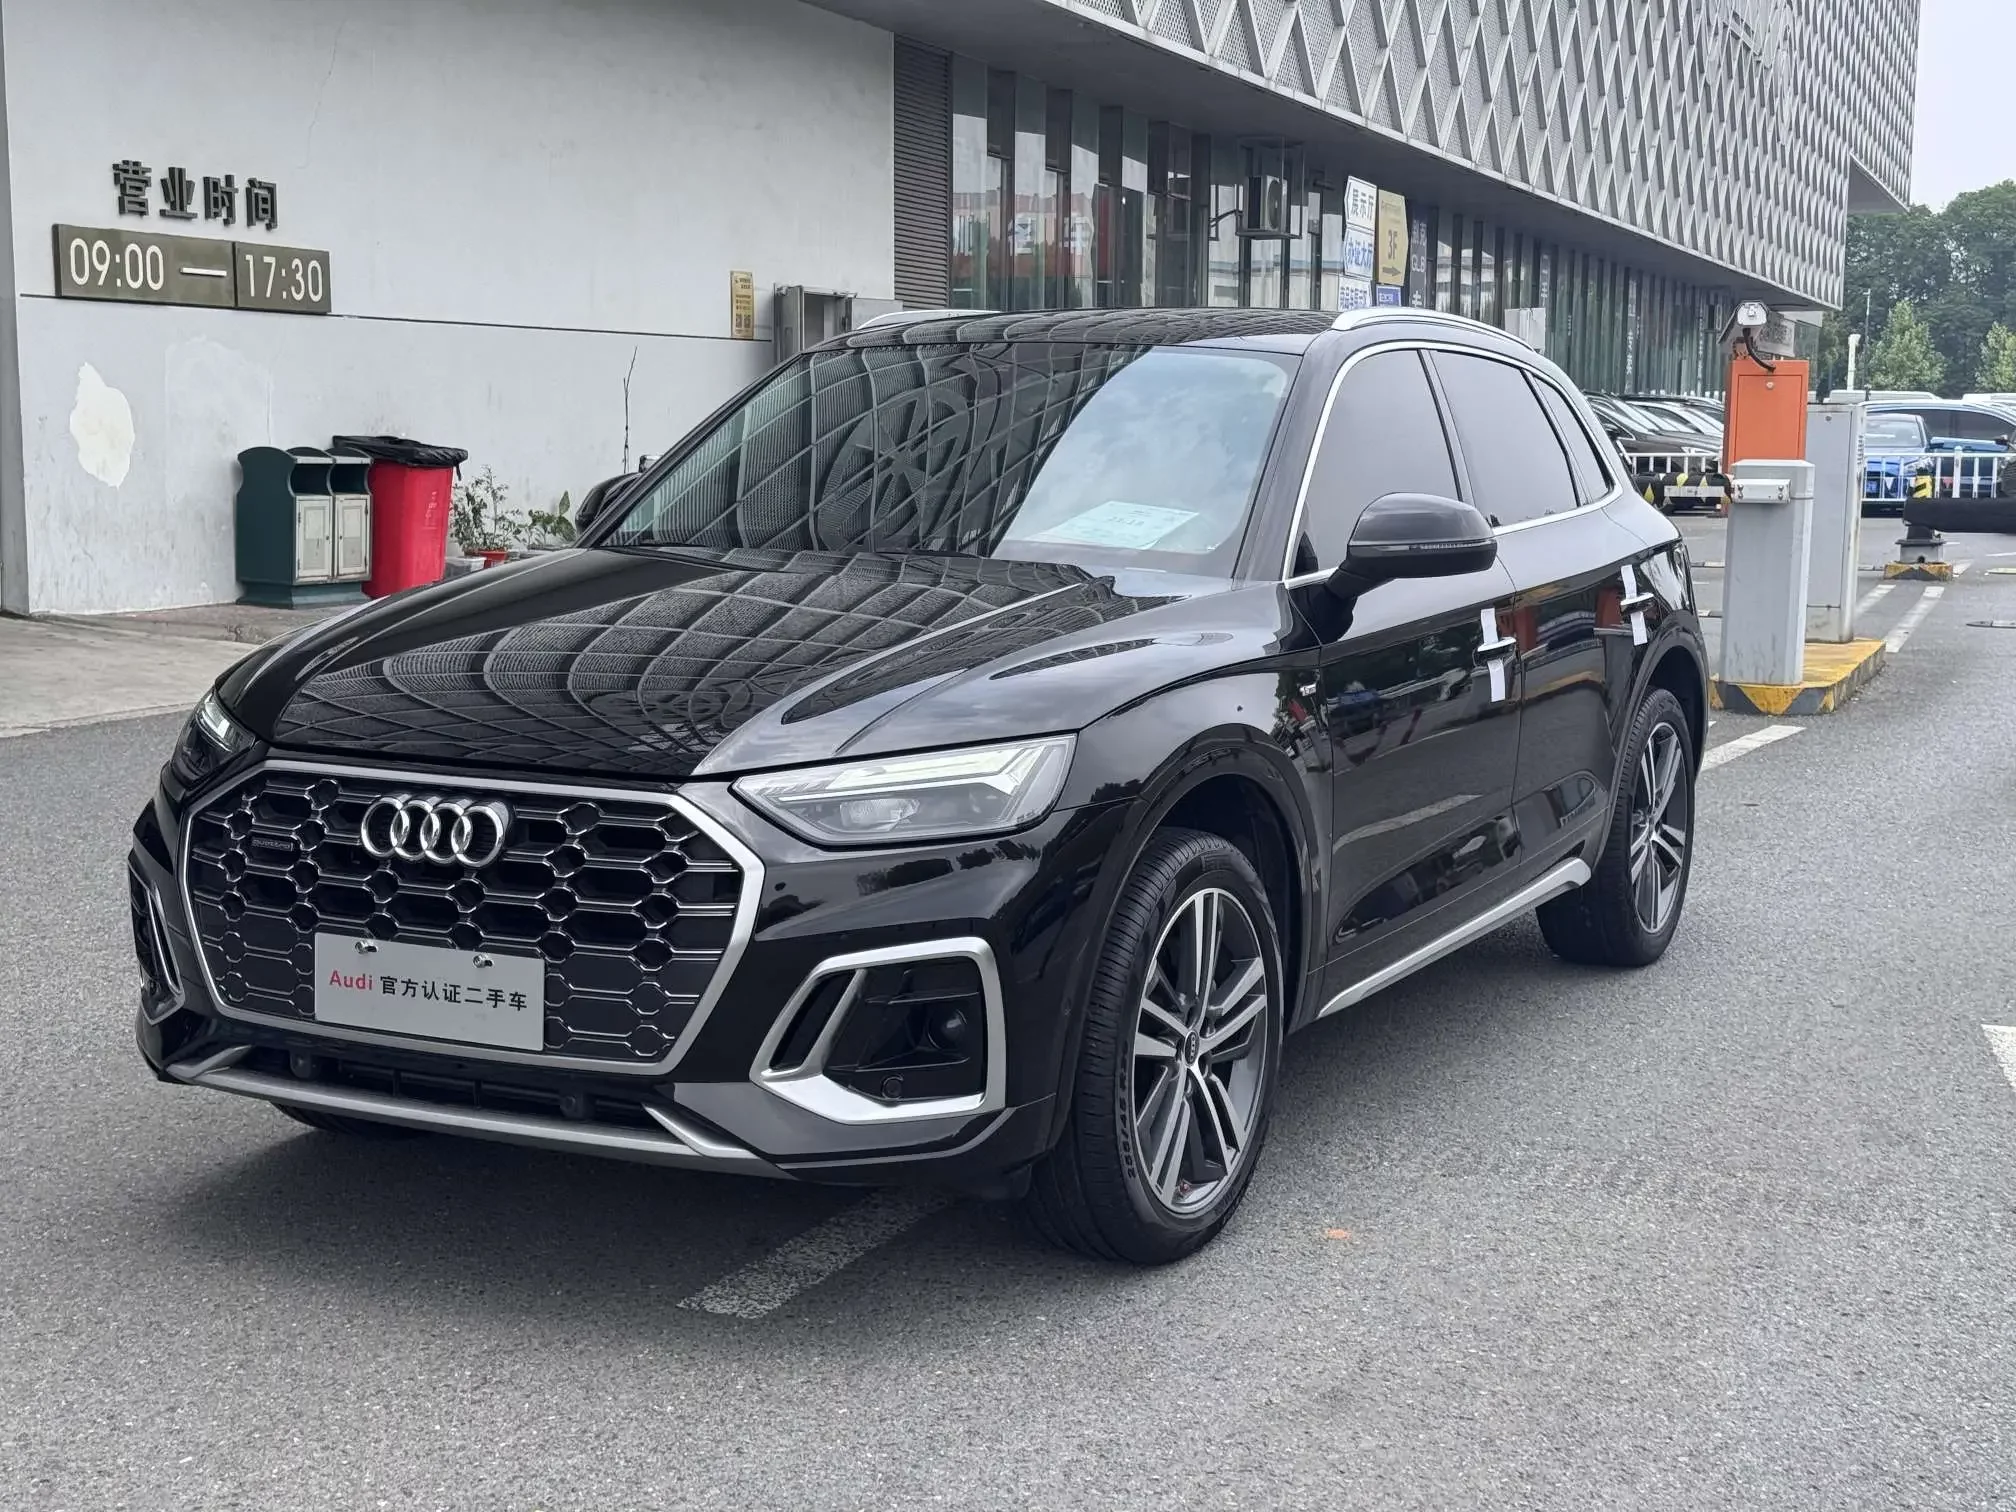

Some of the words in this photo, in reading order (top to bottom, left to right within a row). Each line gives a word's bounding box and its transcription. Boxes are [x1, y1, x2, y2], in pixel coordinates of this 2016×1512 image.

[112, 160, 278, 231] 营业时间
[69, 238, 165, 291] 09:00
[245, 254, 323, 302] 17:30
[1388, 229, 1399, 261] 3F
[329, 969, 374, 991] Audi
[380, 975, 528, 1012] 官方认证二手车
